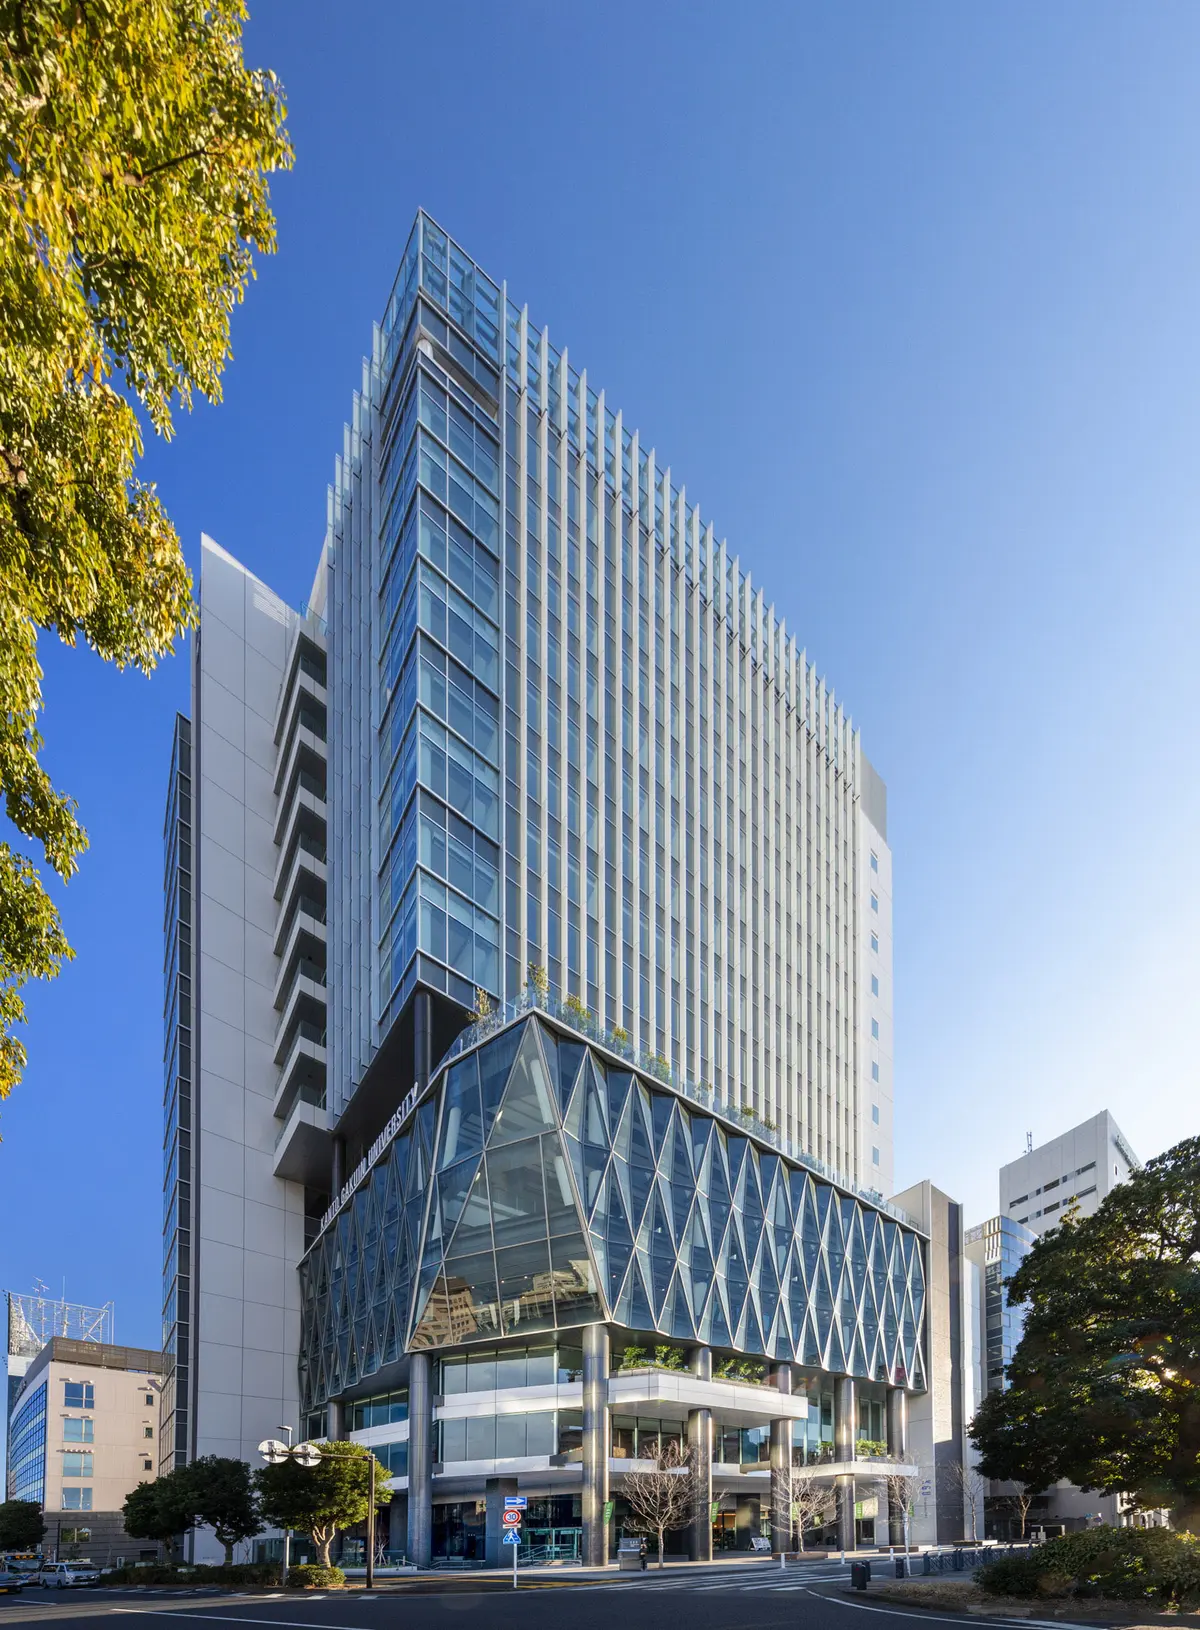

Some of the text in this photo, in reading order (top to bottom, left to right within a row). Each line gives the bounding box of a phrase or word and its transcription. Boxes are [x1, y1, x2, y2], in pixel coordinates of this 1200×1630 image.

[320, 1196, 340, 1232] KANTO
[368, 1081, 418, 1166] UNIVERSITY
[506, 1513, 517, 1521] 30
